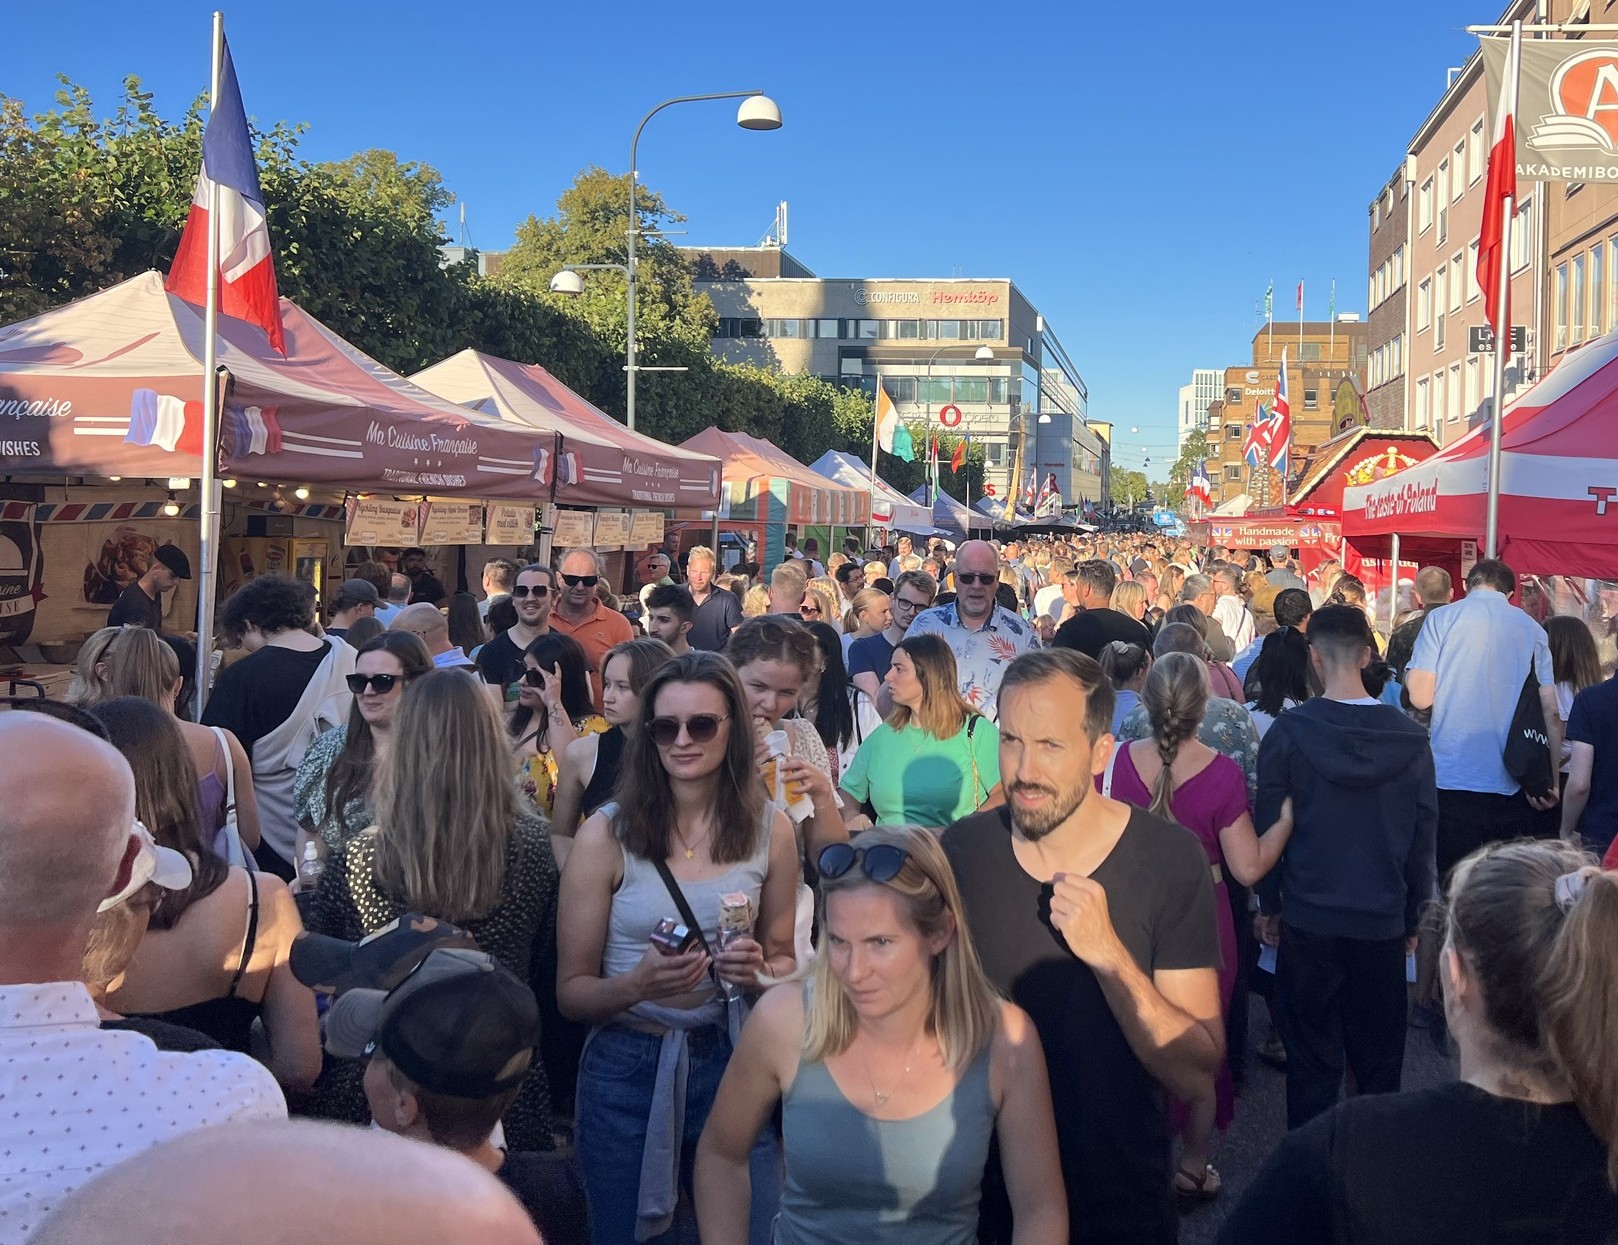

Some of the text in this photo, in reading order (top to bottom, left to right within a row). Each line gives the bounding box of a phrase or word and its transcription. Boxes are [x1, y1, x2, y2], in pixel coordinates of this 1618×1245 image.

[871, 291, 920, 304] CONFIGURA
[931, 290, 999, 306] Hemköp
[1245, 387, 1276, 396] Deloitt
[965, 411, 999, 424] Opera
[366, 420, 478, 458] Ma Cuisine Française
[0, 440, 41, 456] ISHES
[622, 456, 680, 480] Ma Cuisine Française
[382, 468, 467, 487] TRADITIONAL FRENCH DISHES
[1365, 477, 1438, 520] The taste of Poland
[1239, 526, 1295, 536] Handmade
[1235, 537, 1298, 548] with passion
